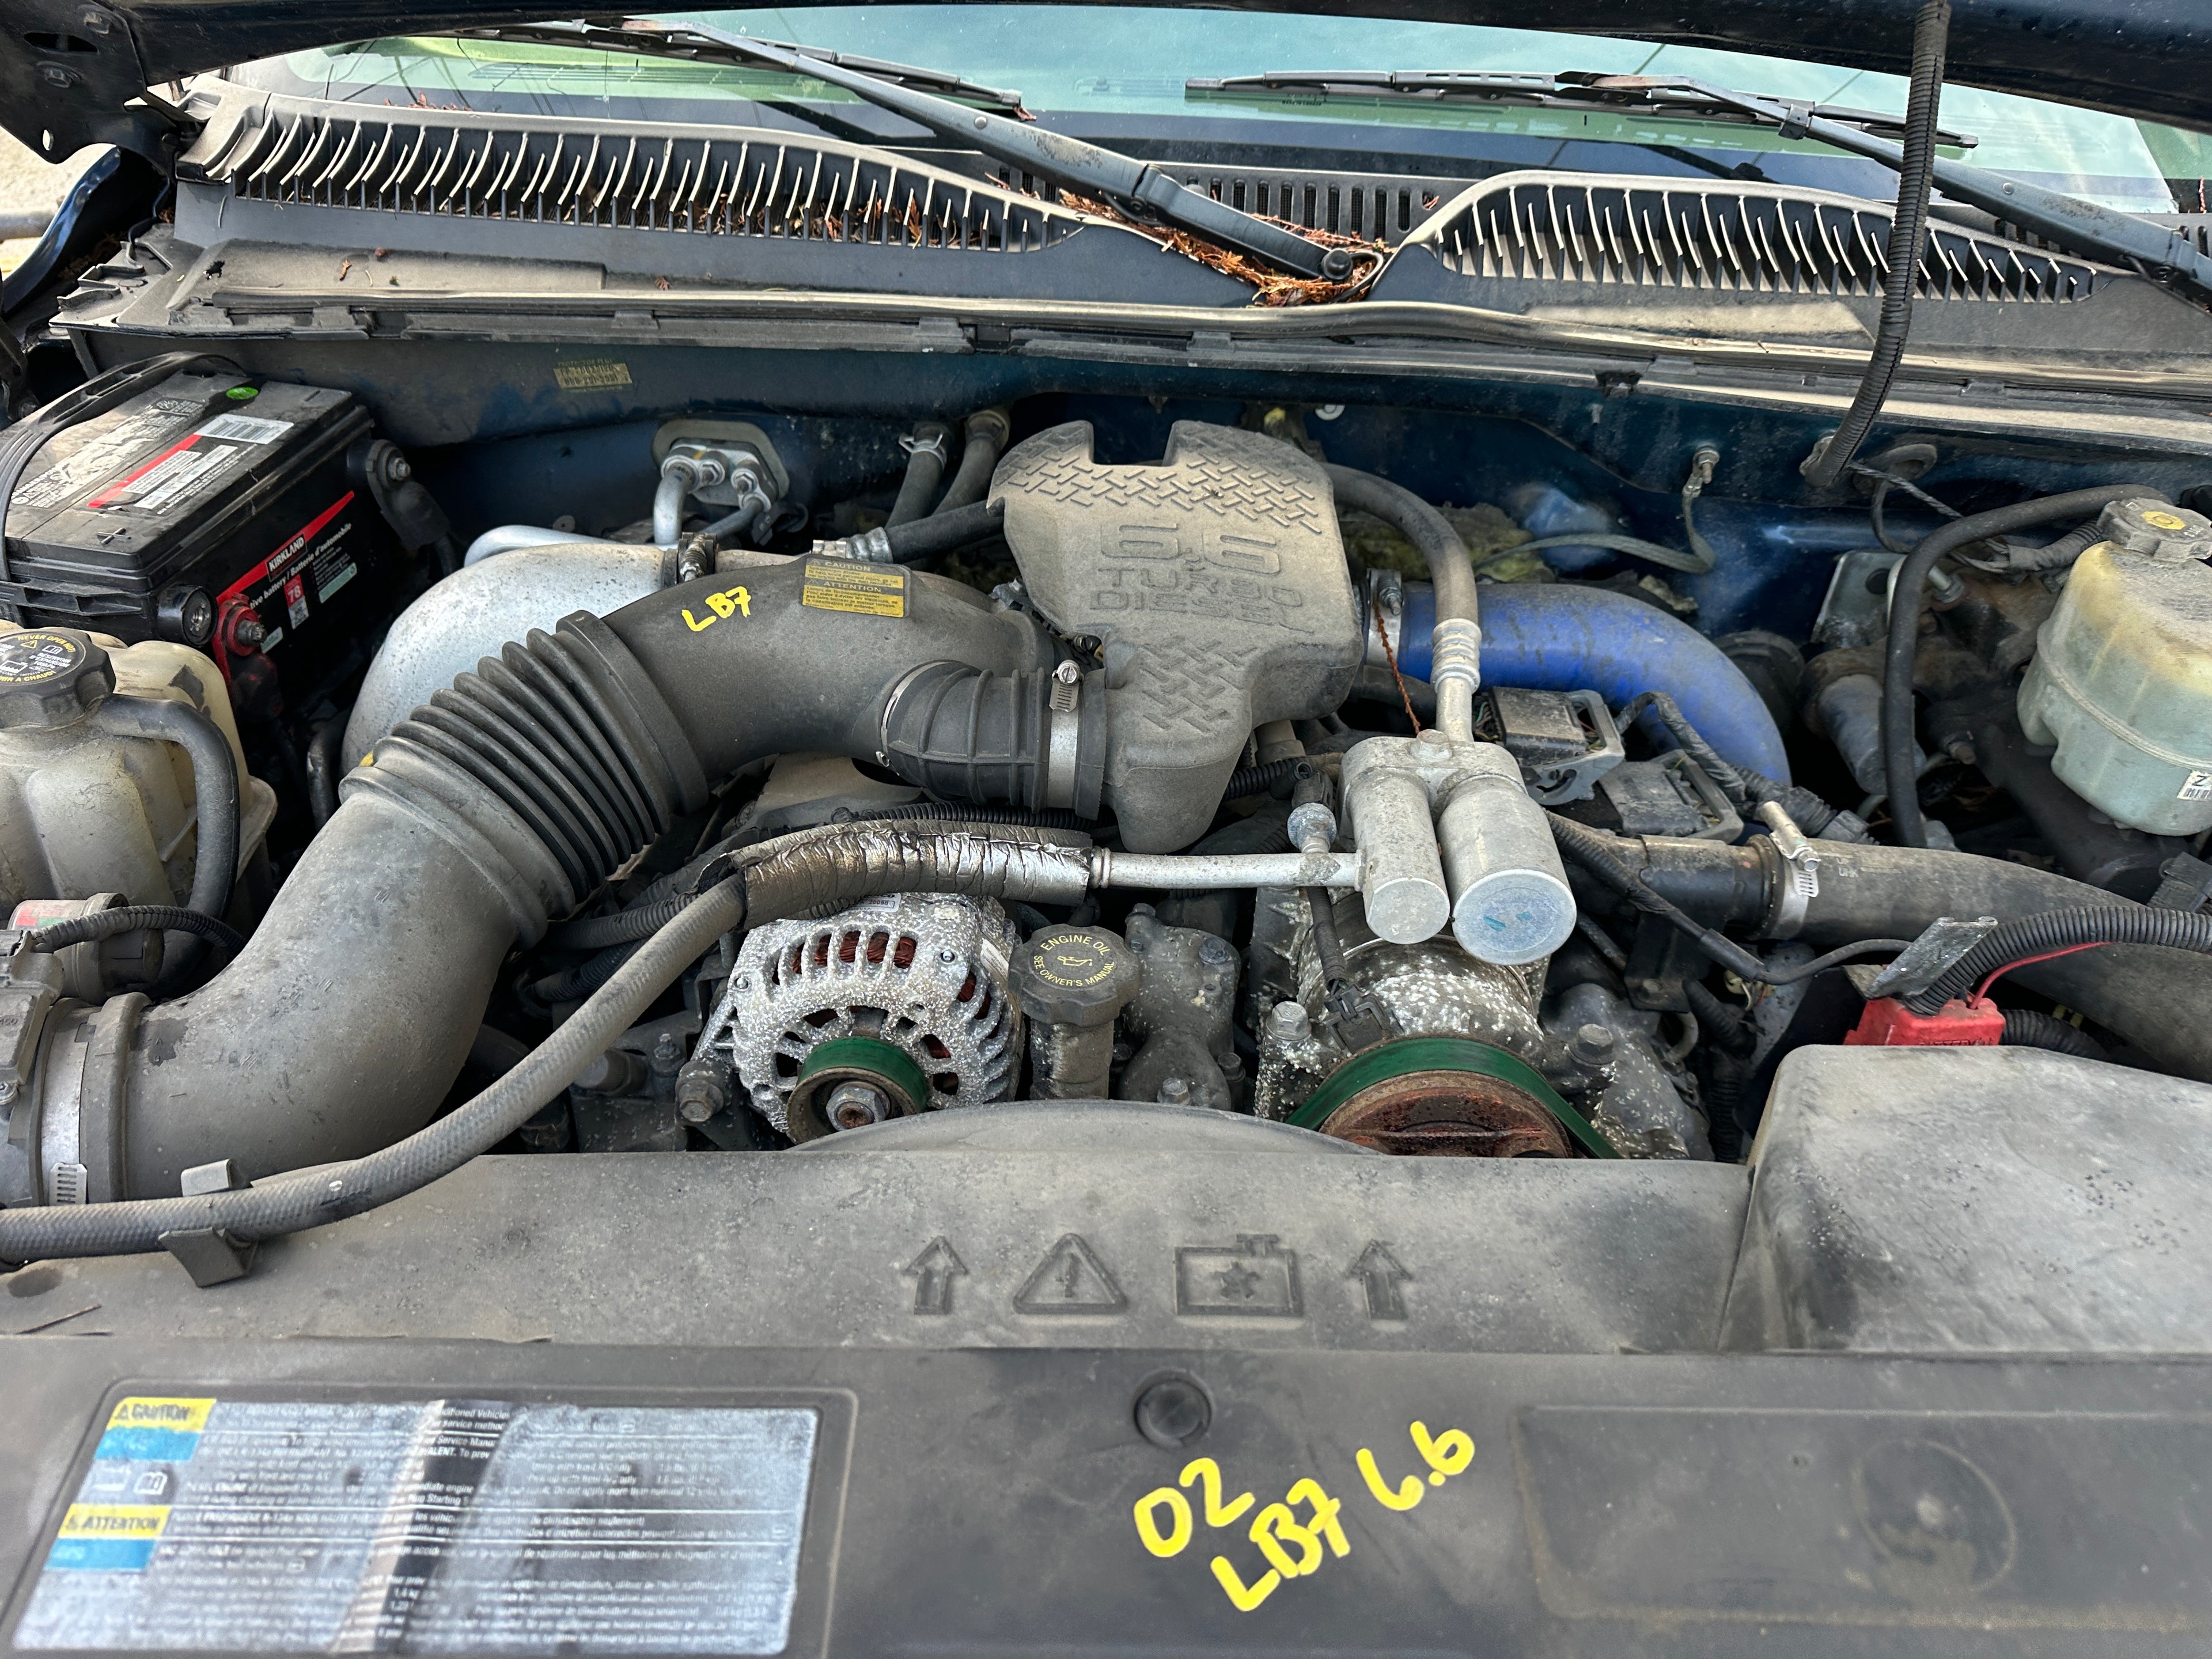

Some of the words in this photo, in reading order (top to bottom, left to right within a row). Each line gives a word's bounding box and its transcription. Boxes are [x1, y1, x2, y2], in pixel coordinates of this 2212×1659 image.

[268, 537, 304, 572] KIRKLAND
[825, 562, 870, 571] CAUTION
[288, 585, 301, 603] 78
[824, 581, 881, 592] ATTENTION
[1097, 567, 1302, 608] TURBO
[681, 586, 751, 632] LB7
[1089, 590, 1315, 635] DIESEL
[47, 635, 66, 645] OPEN
[24, 670, 57, 682] CHAUD!
[1040, 934, 1093, 951] ENGINE
[1093, 941, 1111, 956] OIL
[1033, 955, 1046, 969] SEE
[1039, 969, 1083, 987] OWNER'S
[1085, 961, 1115, 985] MANUAL
[131, 1403, 191, 1421] CAUTION
[1134, 1457, 1256, 1558] 02
[1210, 1477, 1351, 1612] LB7
[1357, 1420, 1475, 1511] 6.6
[81, 1516, 161, 1531] ATTENTION
